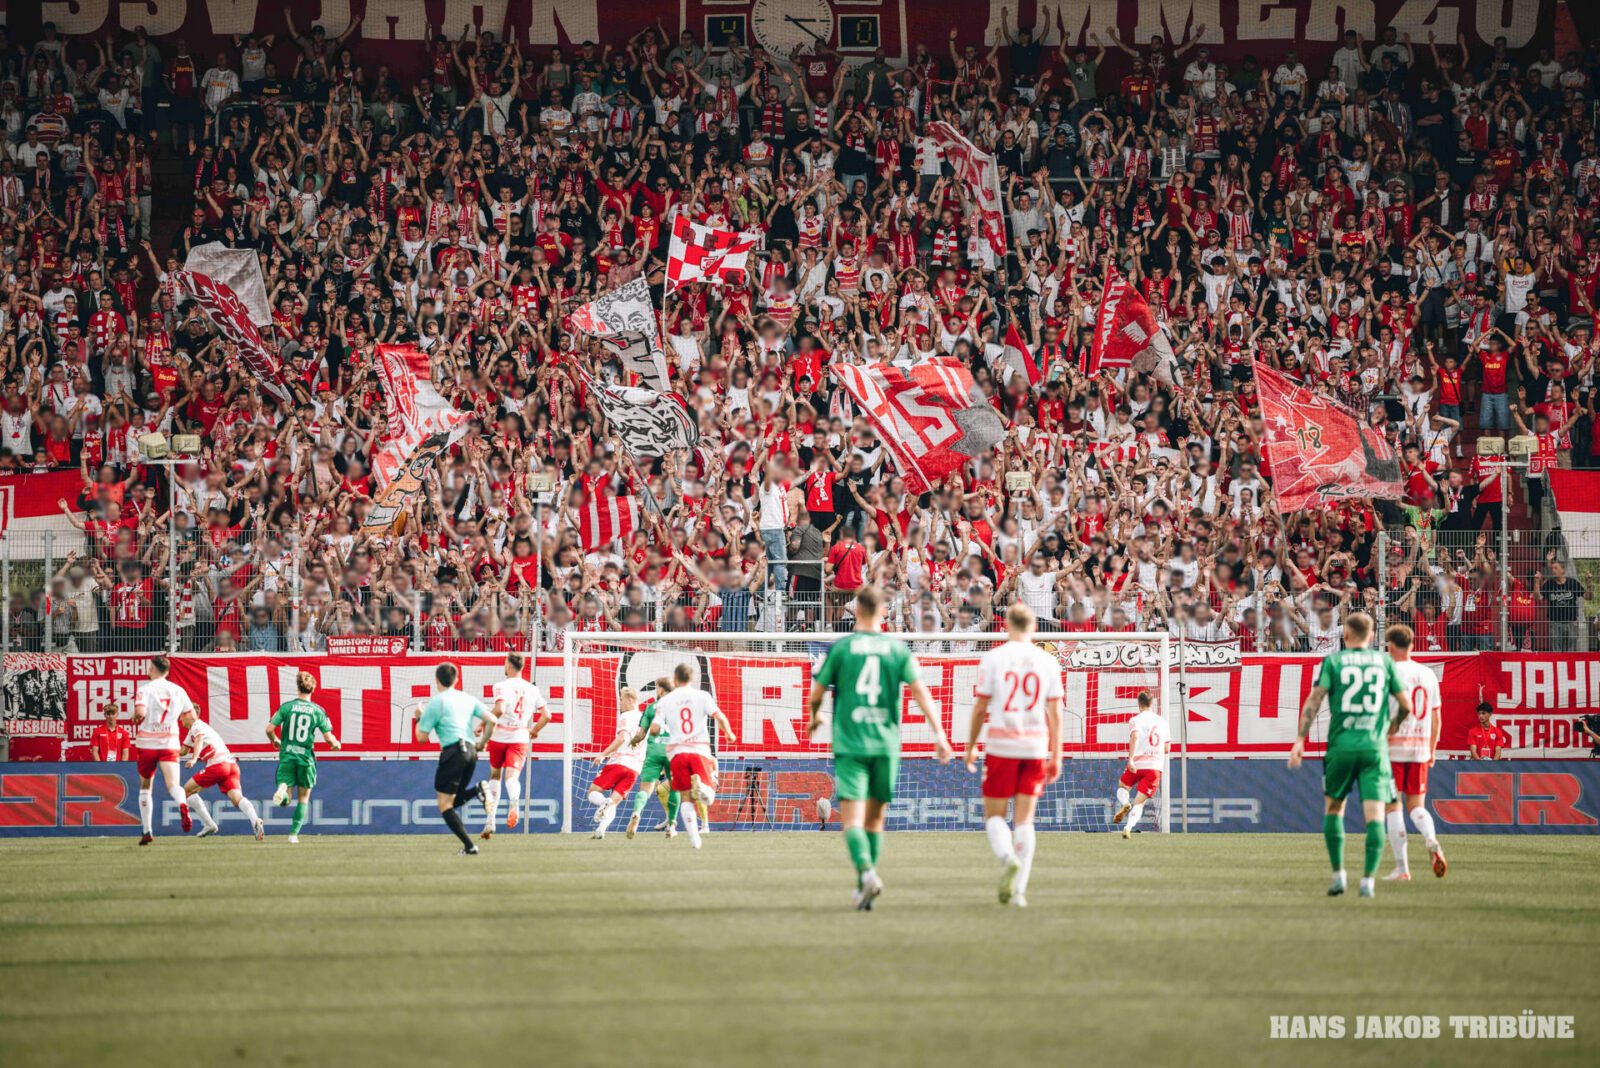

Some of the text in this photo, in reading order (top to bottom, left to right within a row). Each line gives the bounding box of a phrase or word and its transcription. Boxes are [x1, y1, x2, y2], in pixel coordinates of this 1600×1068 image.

[1297, 427, 1321, 449] 18
[329, 636, 388, 646] CHRISTOPH FÜR
[329, 646, 388, 655] IMMER BEI UNS
[72, 658, 106, 676] SSV
[855, 655, 882, 706] 4
[1003, 670, 1041, 713] 29
[1340, 666, 1386, 713] 23
[158, 697, 171, 724] 7
[513, 695, 525, 720] 4
[288, 713, 311, 743] 18
[679, 706, 694, 736] 8
[1148, 725, 1160, 748] 6
